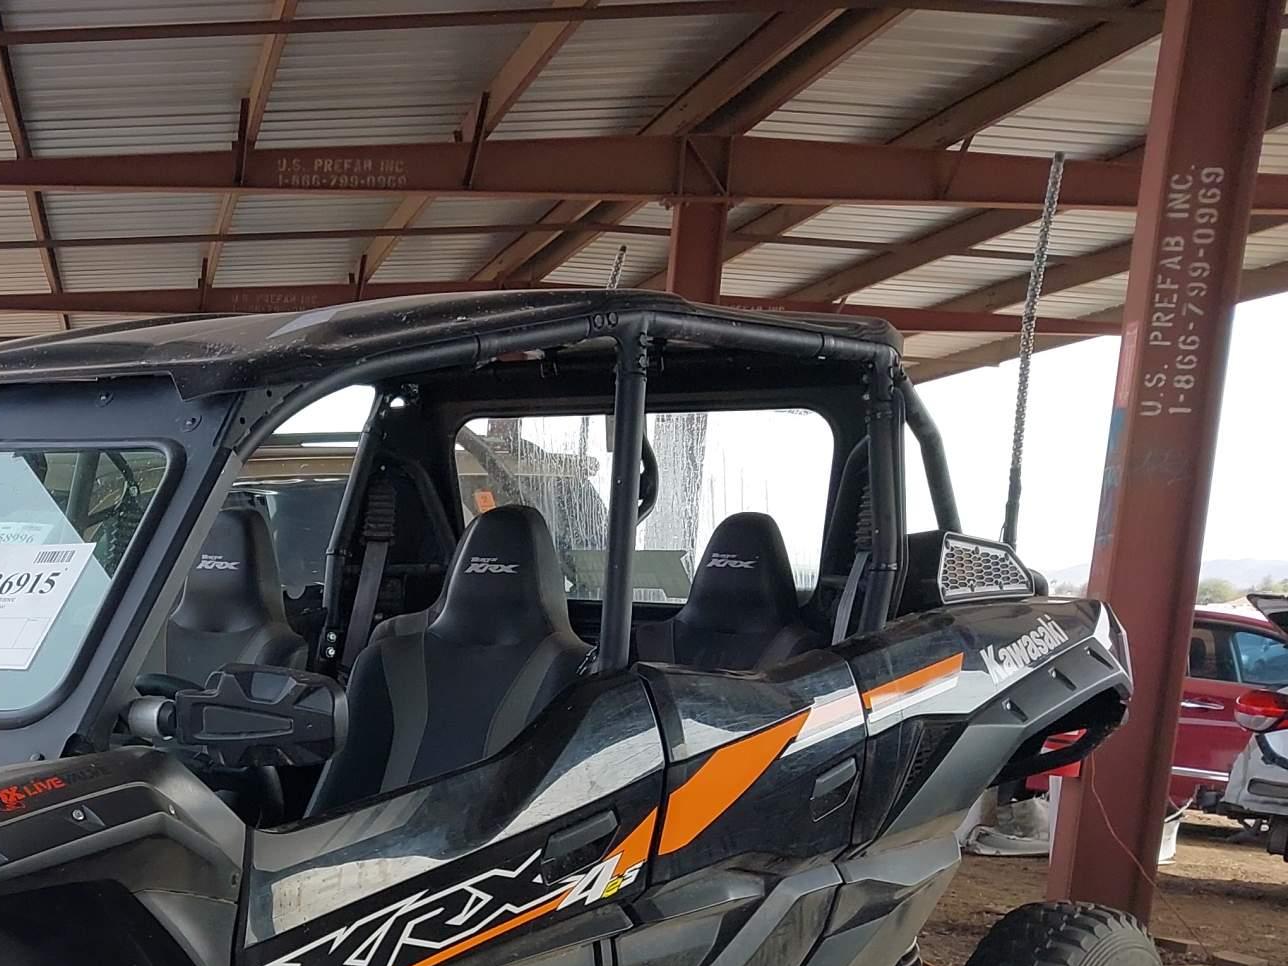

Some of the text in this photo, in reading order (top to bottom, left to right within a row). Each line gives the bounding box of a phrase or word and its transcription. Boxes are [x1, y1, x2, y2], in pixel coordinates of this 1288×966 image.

[1139, 164, 1196, 417] U.S. PREFAB INC.
[1168, 166, 1226, 415] 1-866-799-0969
[979, 613, 1070, 685] Kawasaki
